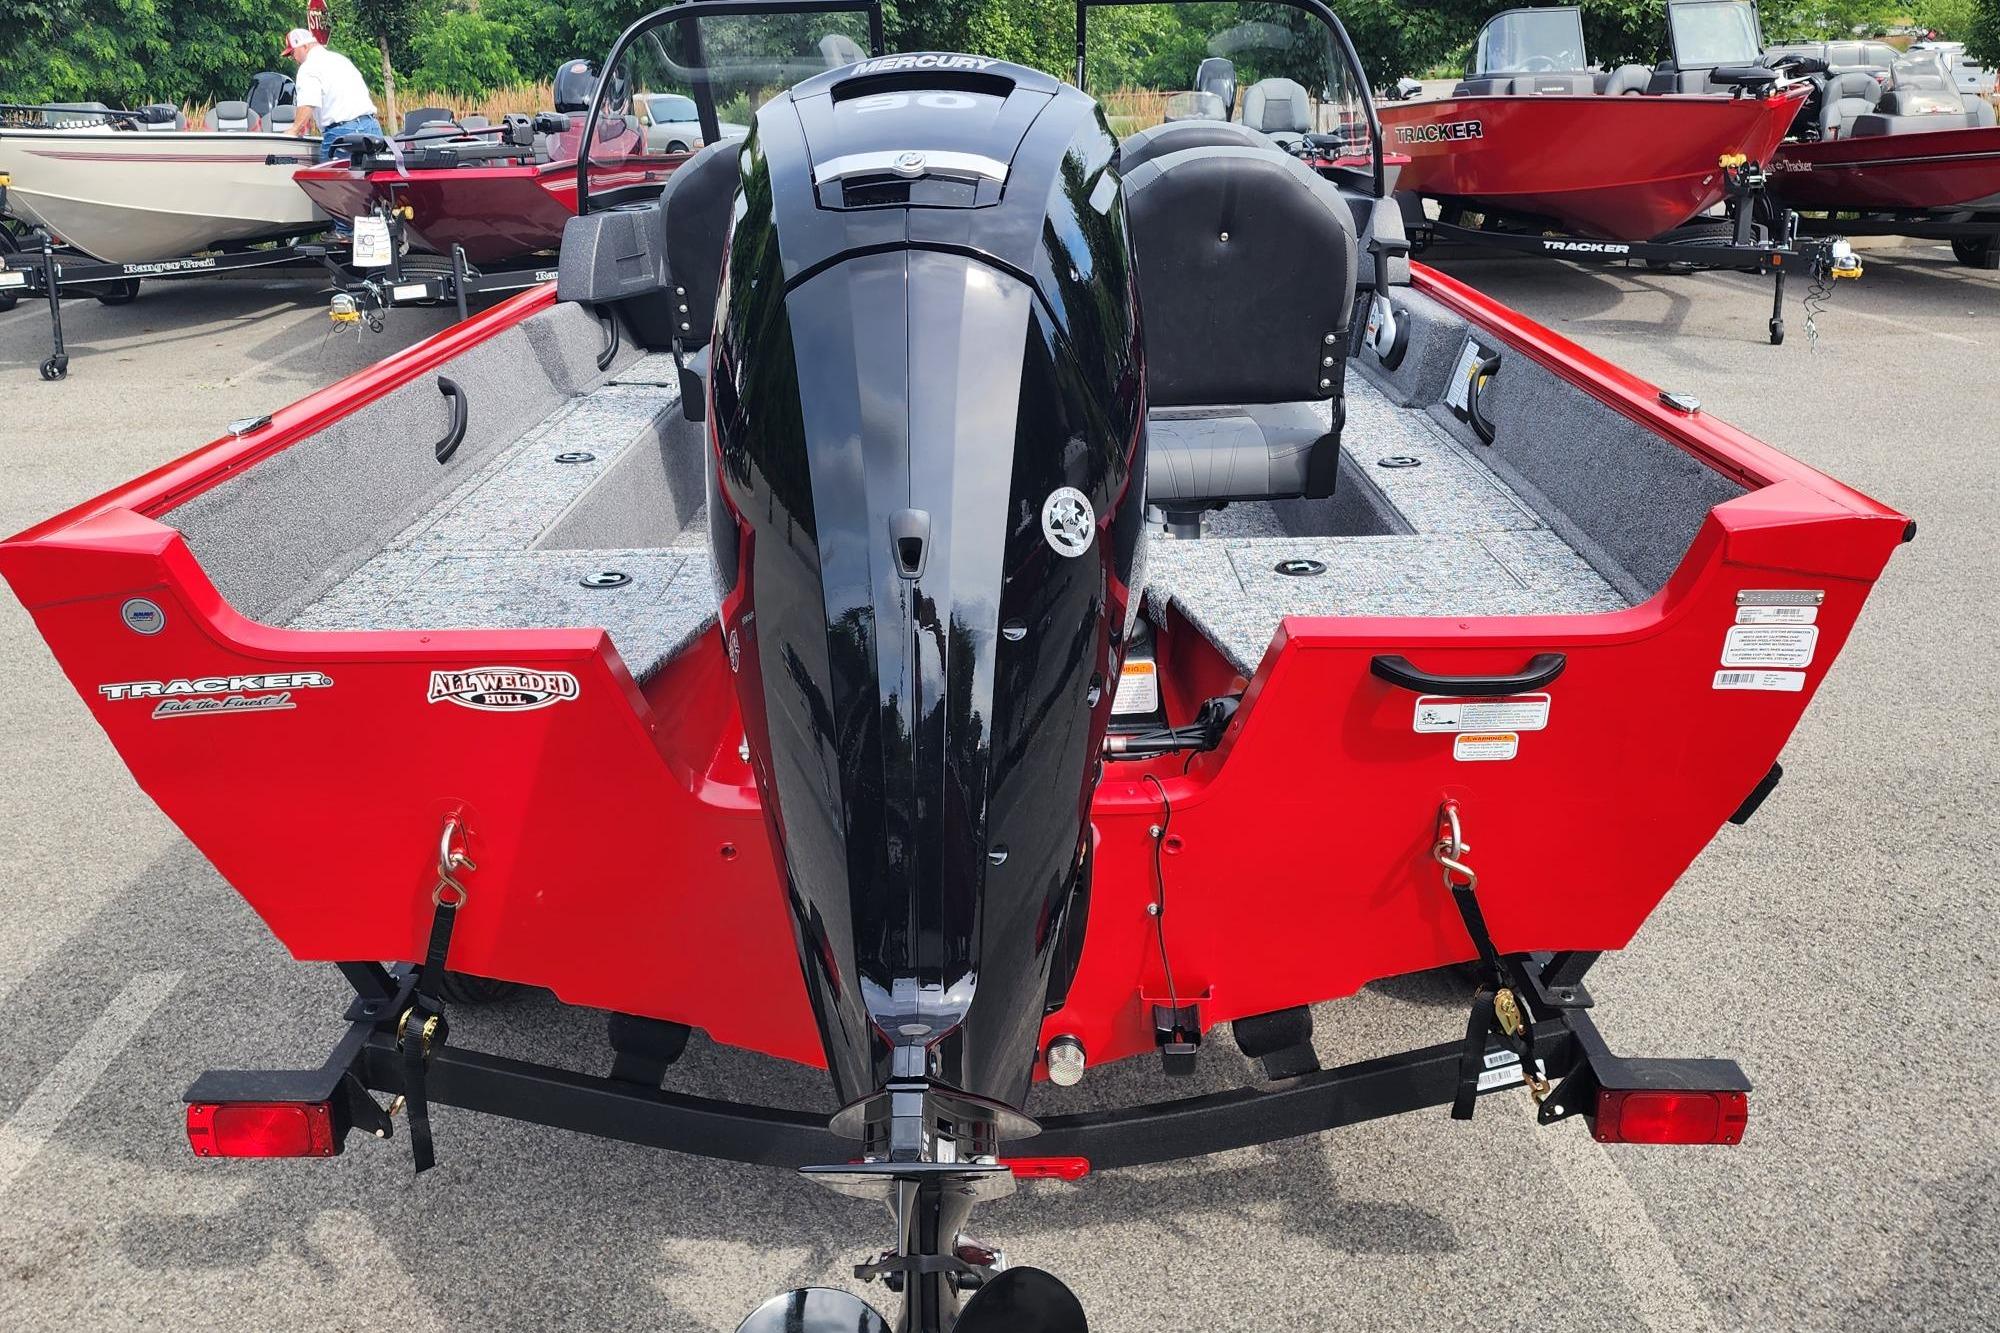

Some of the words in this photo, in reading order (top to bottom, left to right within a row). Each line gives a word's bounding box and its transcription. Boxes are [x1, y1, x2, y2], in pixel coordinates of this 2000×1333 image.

[850, 55, 998, 76] MERCURY
[855, 94, 977, 113] 90
[1396, 120, 1483, 144] TRACKER
[1783, 159, 1812, 172] Tracker
[1543, 240, 1630, 254] TRACKER
[123, 262, 181, 274] Ranger
[180, 257, 216, 269] Trail
[536, 271, 559, 281] Ran
[101, 673, 322, 700] TRACKER
[432, 674, 477, 698] ALL
[474, 673, 575, 697] WELDED
[158, 700, 192, 713] Fish
[196, 698, 220, 709] the
[484, 694, 527, 705] HULL
